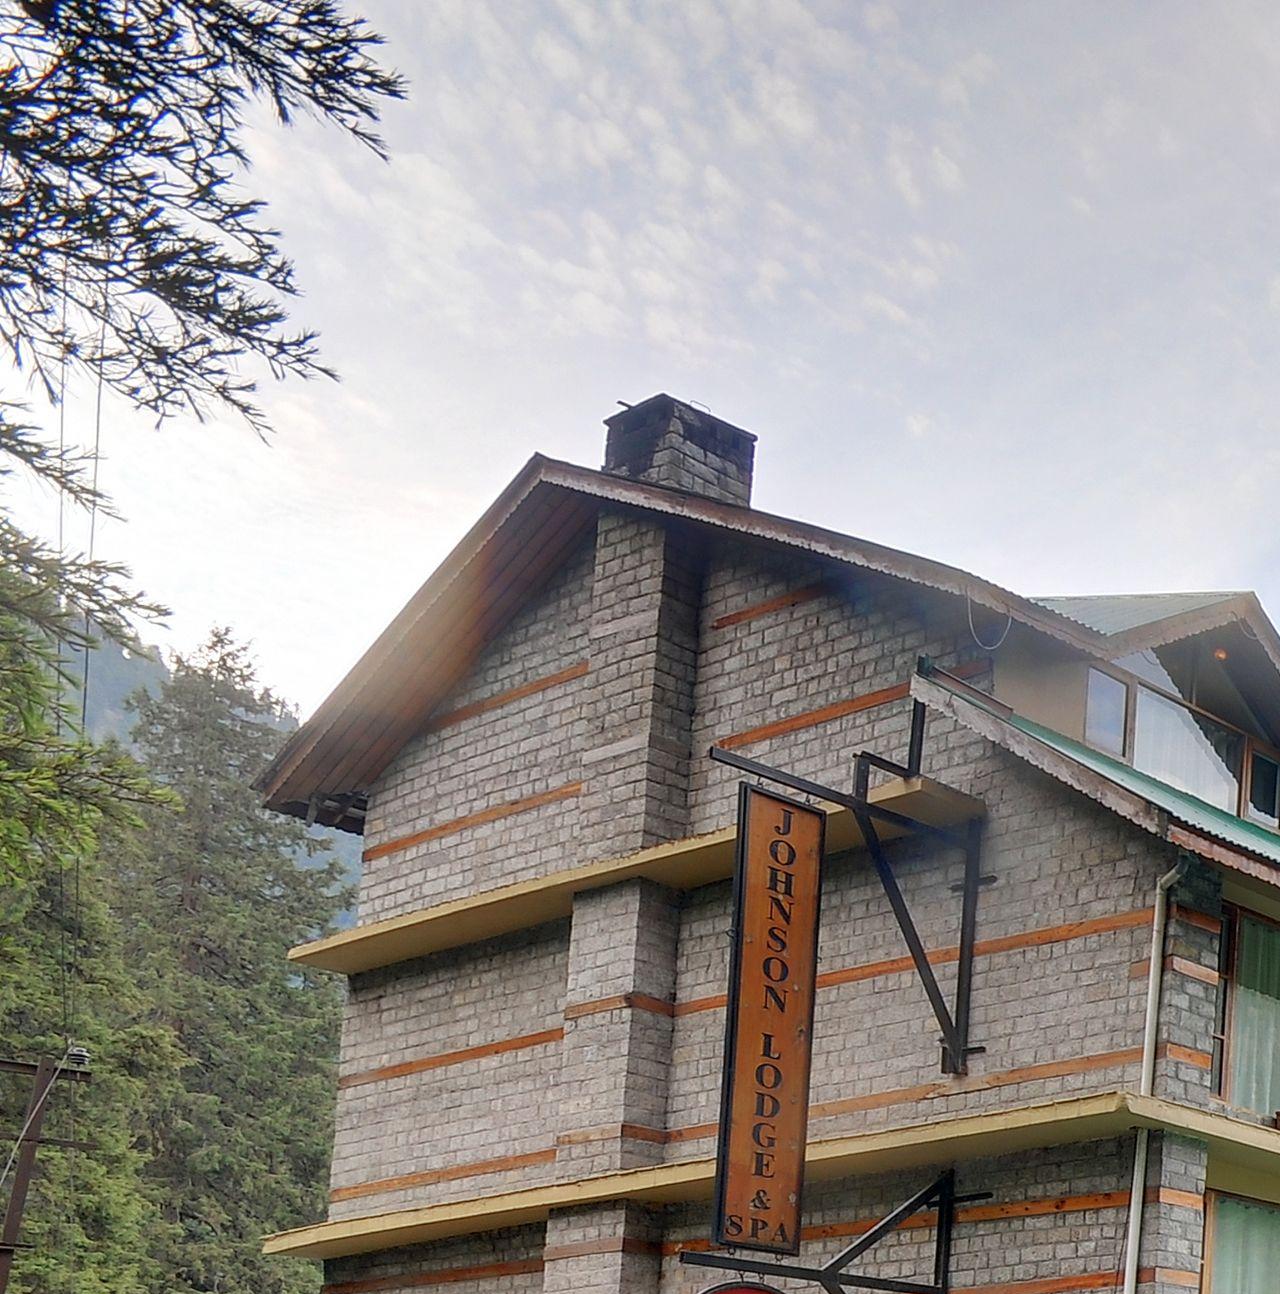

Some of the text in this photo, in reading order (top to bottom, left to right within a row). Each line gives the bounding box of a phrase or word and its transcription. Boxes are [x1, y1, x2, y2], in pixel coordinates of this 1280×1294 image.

[752, 808, 797, 1211] JOHNSON LODGE &
[725, 1214, 790, 1244] SPA
